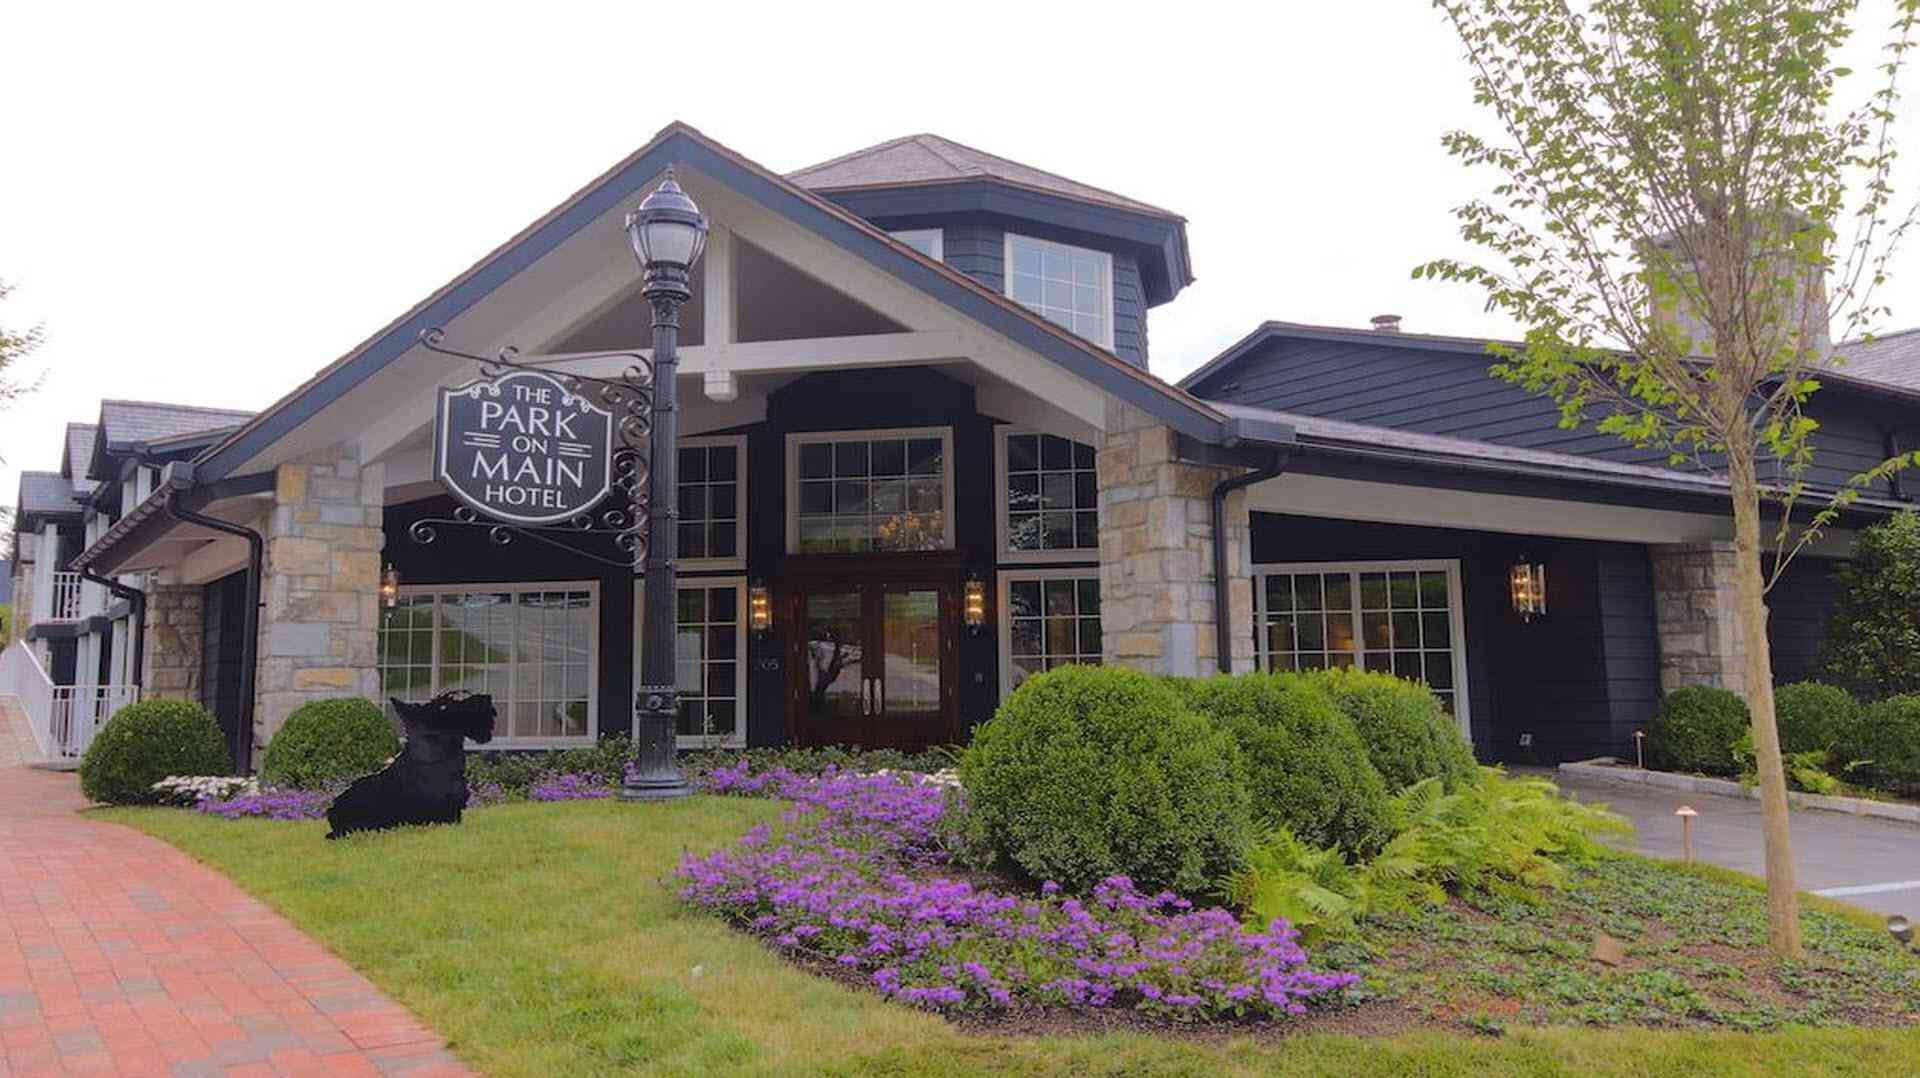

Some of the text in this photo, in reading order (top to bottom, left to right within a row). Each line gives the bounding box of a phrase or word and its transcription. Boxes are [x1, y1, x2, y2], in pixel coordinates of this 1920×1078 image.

[512, 384, 552, 405] THE
[481, 401, 577, 440] PARK
[512, 436, 548, 454] ON
[472, 450, 583, 488] MAIN
[485, 484, 568, 509] HOTEL
